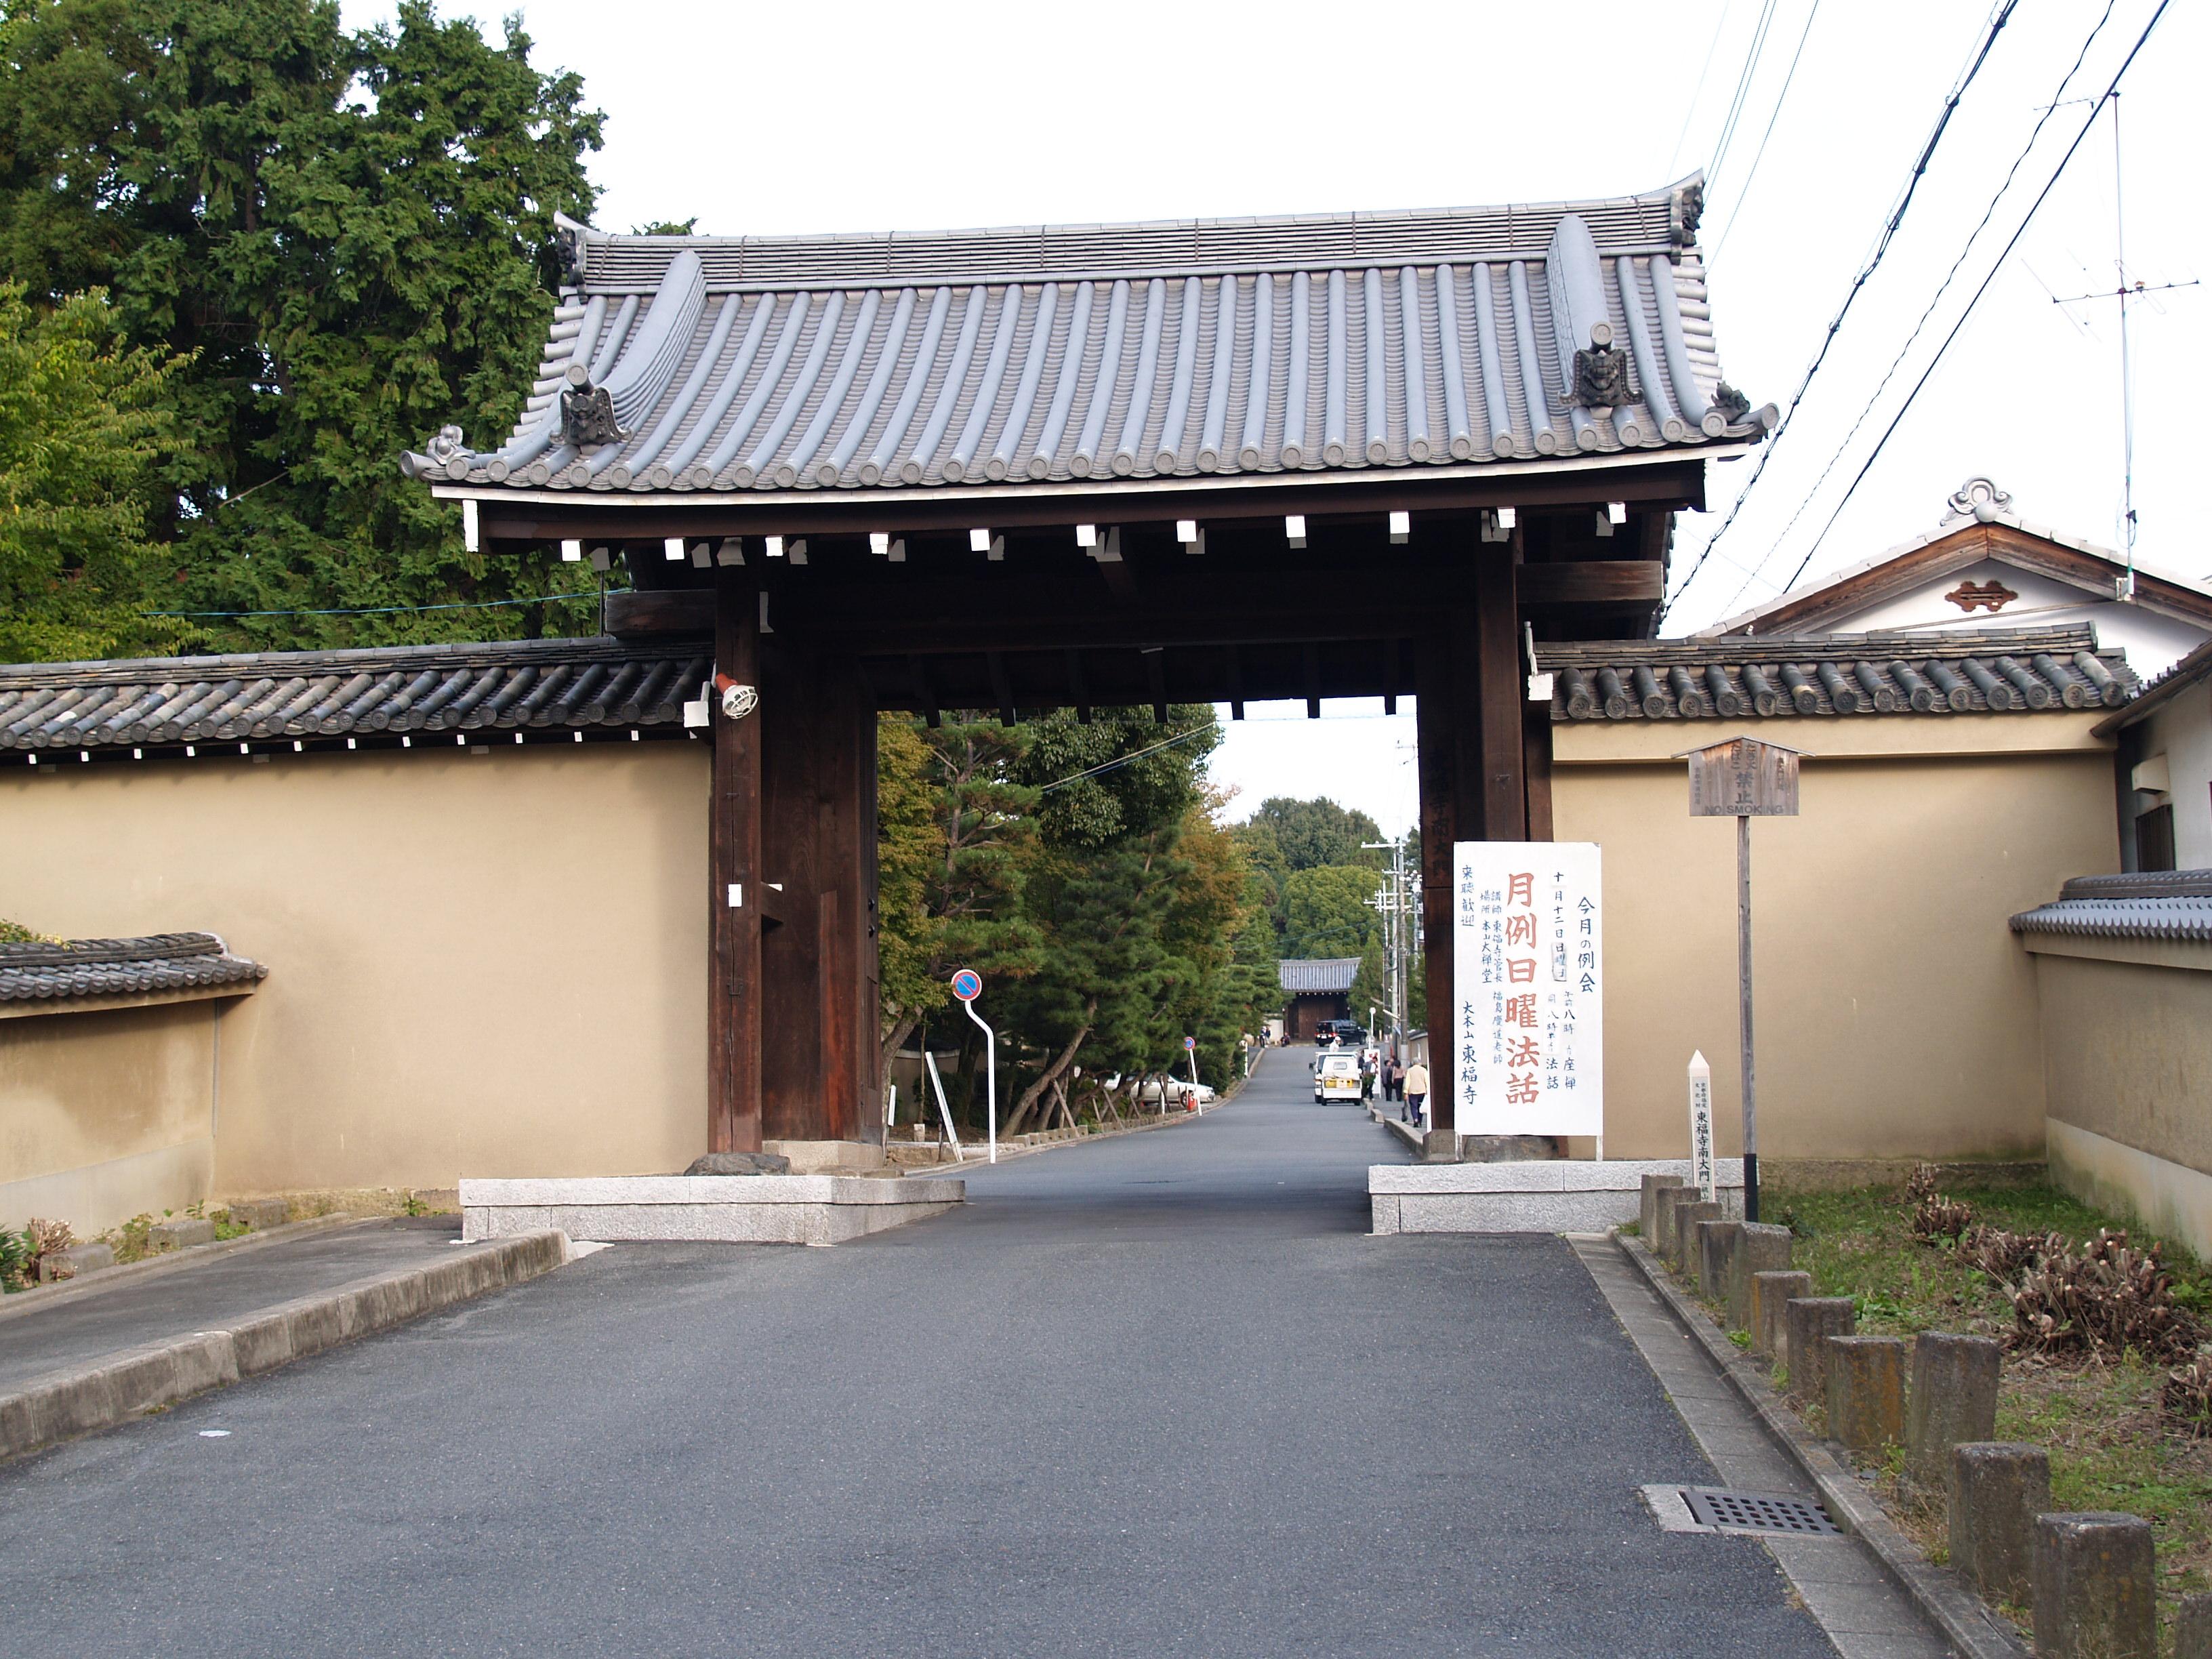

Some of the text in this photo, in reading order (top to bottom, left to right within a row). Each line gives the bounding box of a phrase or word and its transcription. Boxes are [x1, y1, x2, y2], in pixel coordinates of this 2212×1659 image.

[1704, 804, 1784, 814] NO SMOKING
[1735, 771, 1755, 804] 禁止
[1460, 864, 1475, 927] 来聴歓迎
[1577, 896, 1596, 993] 今月の例会
[1505, 872, 1540, 1104] 月例日曜法話
[1460, 1000, 1478, 1105] 大本山東福寺
[1696, 1111, 1711, 1182] 東福寺南大門
